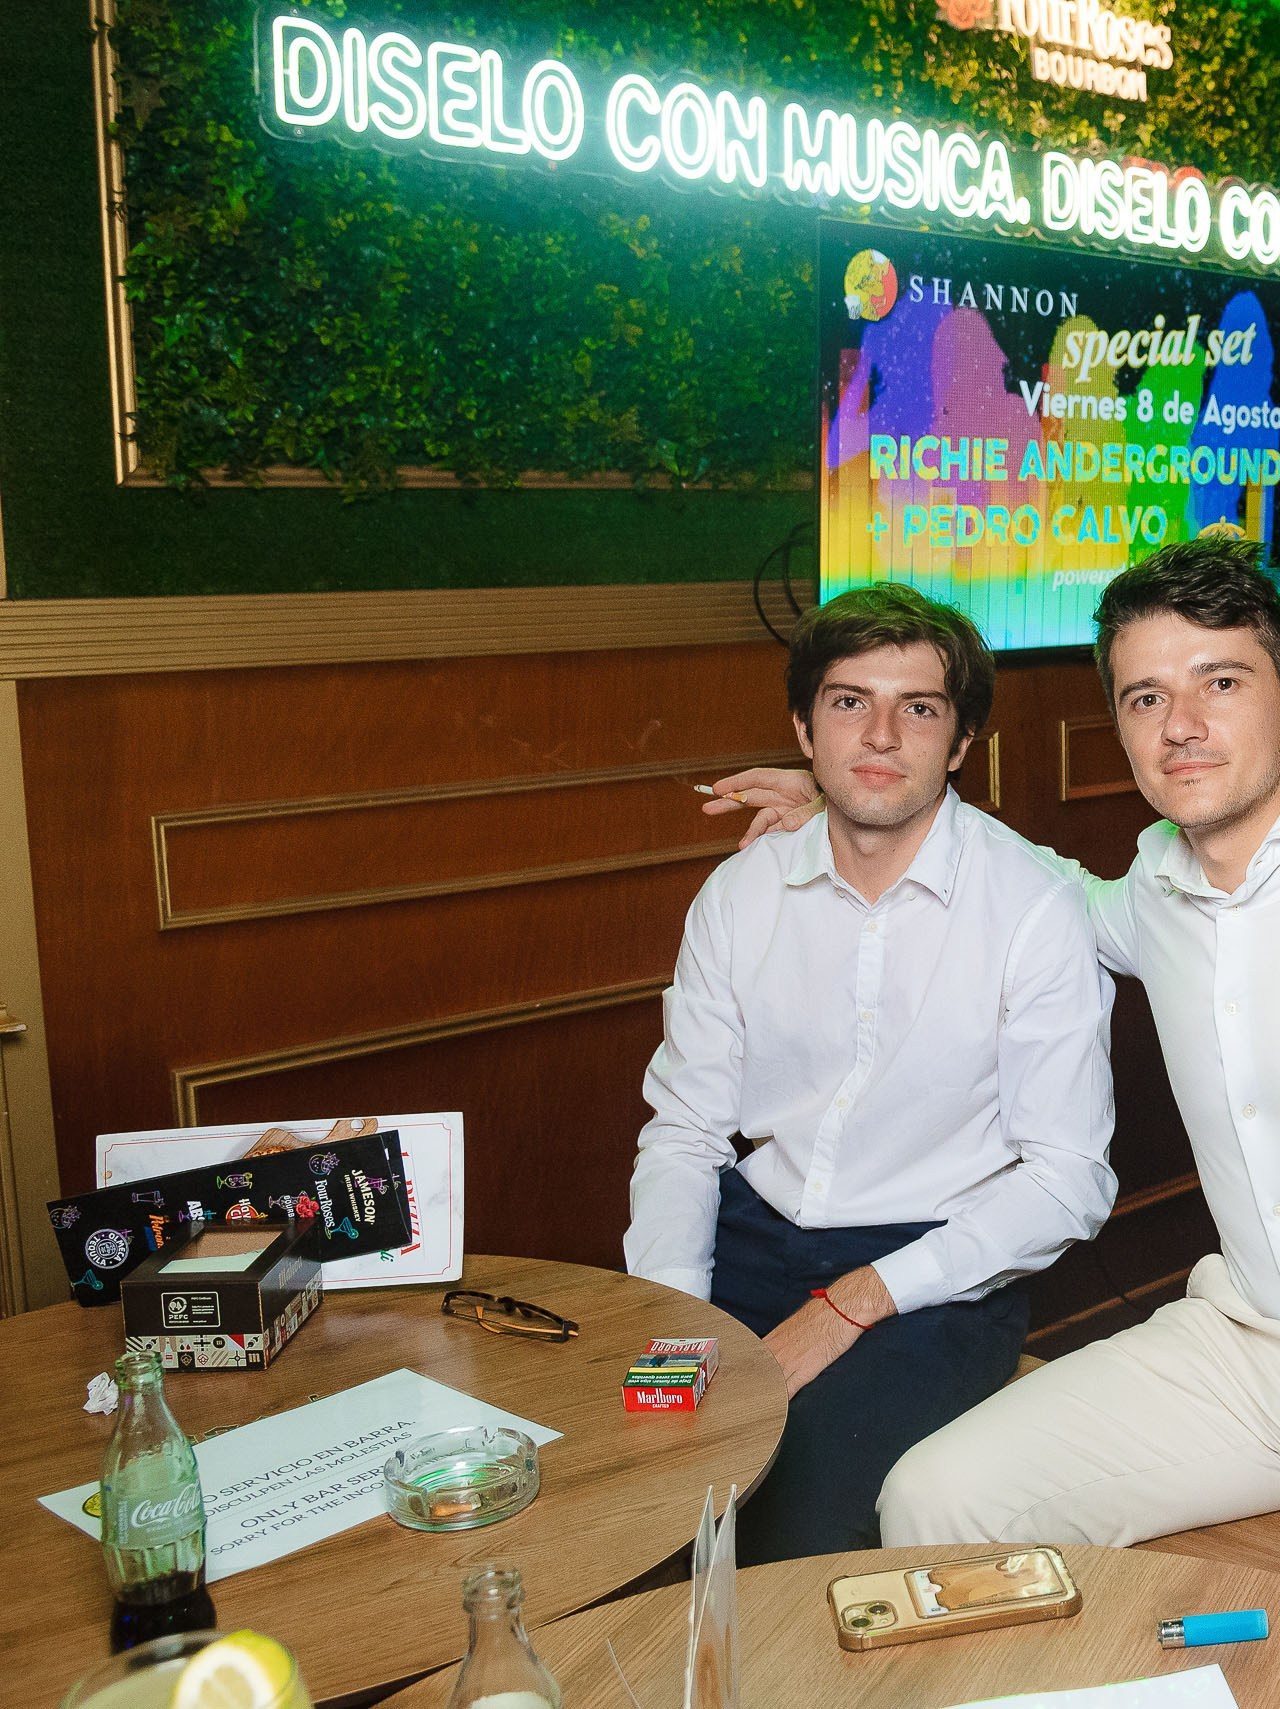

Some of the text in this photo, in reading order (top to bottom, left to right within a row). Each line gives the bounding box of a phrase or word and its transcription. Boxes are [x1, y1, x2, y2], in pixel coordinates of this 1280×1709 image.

[1033, 47, 1148, 103] BOURBON
[272, 14, 585, 161] DISELO
[606, 72, 768, 188] CON
[1041, 150, 1212, 253] DISELO
[908, 275, 1079, 318] SHANNON
[1061, 313, 1257, 384] special set
[1019, 379, 1128, 422] Viernes
[1137, 388, 1154, 424] 8
[1163, 394, 1195, 425] de
[869, 433, 1009, 481] RICHIE
[903, 503, 1042, 548] PEDRO
[1051, 504, 1168, 546] CALVO
[283, 1195, 295, 1218] BOURB
[351, 1169, 376, 1225] JAMESON
[88, 1236, 106, 1266] TEQUILA
[108, 1232, 126, 1262] OLMECA
[636, 1387, 683, 1404] Marlboro
[205, 1431, 412, 1518] DISCULPEN LAS MOLESTIAS
[219, 1420, 416, 1498] SERVICIO EN BARRA.
[210, 1528, 268, 1556] SORRY
[272, 1513, 309, 1532] FOR
[305, 1500, 343, 1516] THE
[240, 1501, 300, 1529] ONLY
[301, 1482, 349, 1505] BAR
